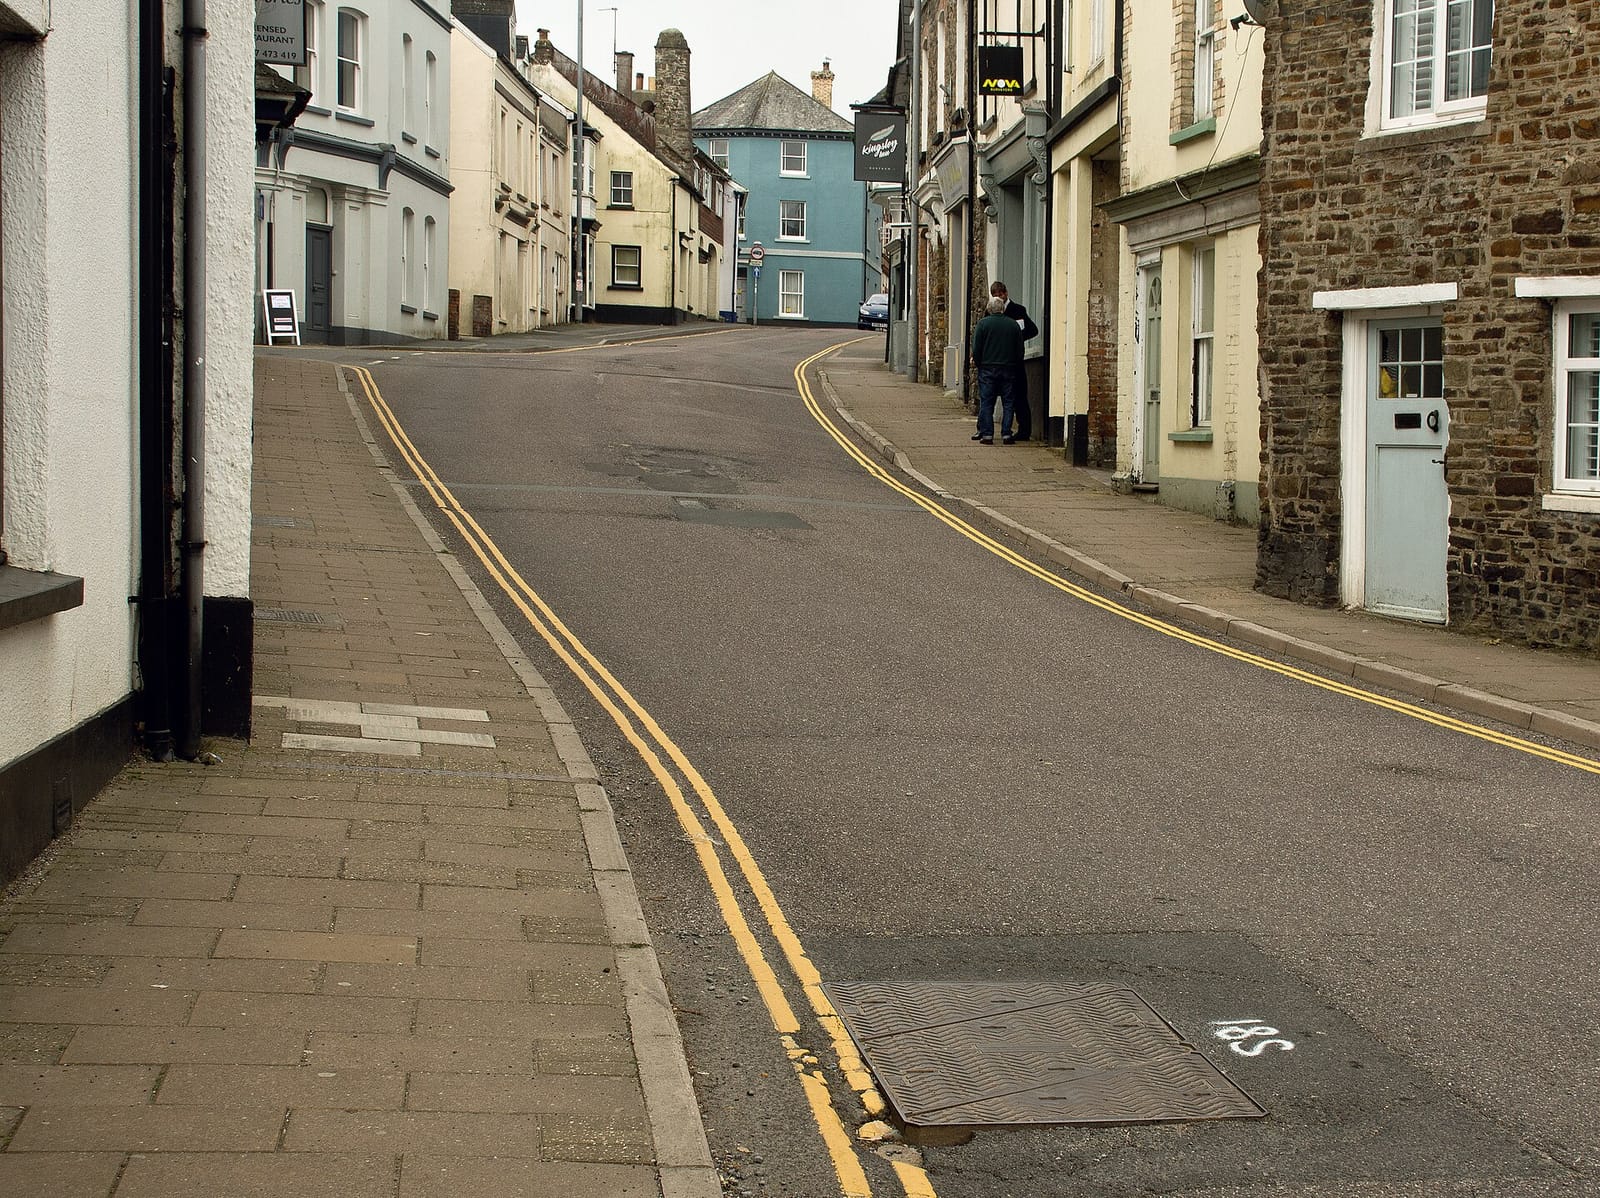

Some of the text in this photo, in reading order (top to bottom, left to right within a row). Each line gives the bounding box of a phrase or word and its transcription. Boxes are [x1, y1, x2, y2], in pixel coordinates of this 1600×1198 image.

[256, 25, 287, 34] ENSED
[255, 34, 295, 44] AURANT
[262, 50, 278, 58] 473
[281, 52, 297, 60] 419
[982, 79, 1020, 88] NOVA
